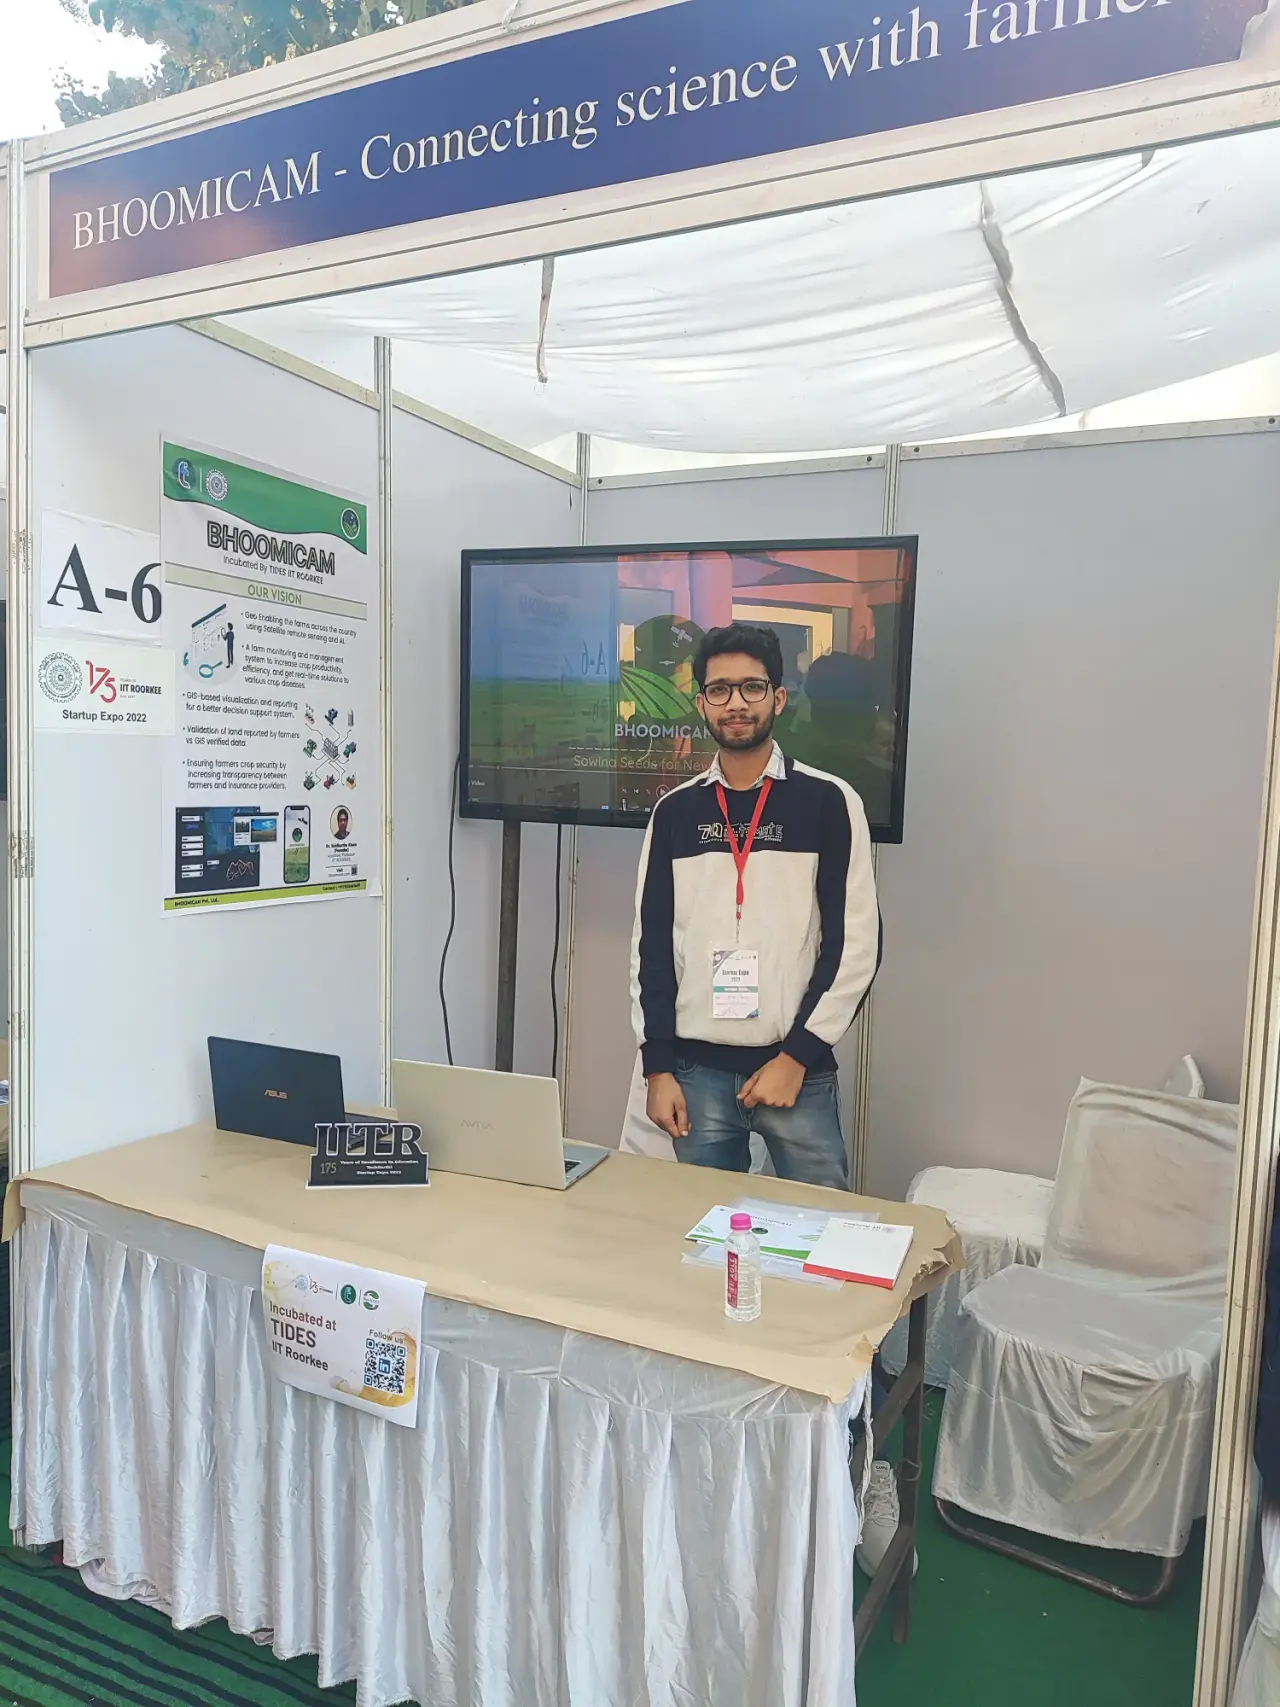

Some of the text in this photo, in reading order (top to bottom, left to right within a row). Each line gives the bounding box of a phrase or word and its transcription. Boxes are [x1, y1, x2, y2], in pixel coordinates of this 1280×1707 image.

[72, 151, 321, 250] BHOOMICAM
[361, 97, 599, 181] Connecting
[615, 64, 798, 127] science
[818, 16, 943, 82] with
[206, 520, 336, 575] BHOOMICAM
[223, 555, 258, 571] Incubated
[260, 562, 267, 574] By
[269, 565, 286, 577] TIDES
[296, 571, 324, 585] ROORKEE
[47, 543, 161, 623] A-6
[248, 584, 302, 605] OUR VISION
[245, 611, 257, 620] Geo
[258, 613, 283, 626] Enabling
[284, 617, 293, 626] the
[329, 625, 337, 634] the
[338, 628, 357, 639] country
[263, 624, 286, 636] Satellite
[251, 643, 265, 653] farm
[266, 647, 297, 659] monitoring
[297, 651, 308, 659] and
[309, 653, 344, 664] management
[245, 655, 265, 664] system
[267, 657, 273, 665] to
[274, 657, 297, 668] increase
[298, 662, 311, 671] crop
[245, 676, 266, 685] various
[267, 679, 281, 688] crop
[284, 670, 294, 679] get
[120, 683, 162, 695] IIT ROORKEE
[186, 691, 298, 711] GIS-based visualization and reporting
[62, 709, 147, 723] Startup Expo 2022
[186, 703, 195, 711] for
[202, 703, 221, 713] better
[223, 706, 249, 715] decision
[250, 709, 272, 718] support
[187, 724, 300, 739] Validation of land reported by farmers
[194, 736, 205, 744] GIS
[206, 737, 230, 746] verified
[186, 759, 287, 770] Ensuring farmers crop security by
[661, 758, 678, 770] for
[188, 770, 287, 780] increasing transparency between
[188, 781, 213, 789] farmers
[214, 781, 227, 789] and
[228, 781, 258, 789] insurance
[315, 1123, 425, 1156] IITR
[320, 1162, 337, 1174] 175
[269, 1300, 337, 1332] Incubated at
[270, 1317, 317, 1349] TIDES
[368, 1328, 404, 1344] Follow us
[272, 1339, 329, 1371] IIT Roorkee
